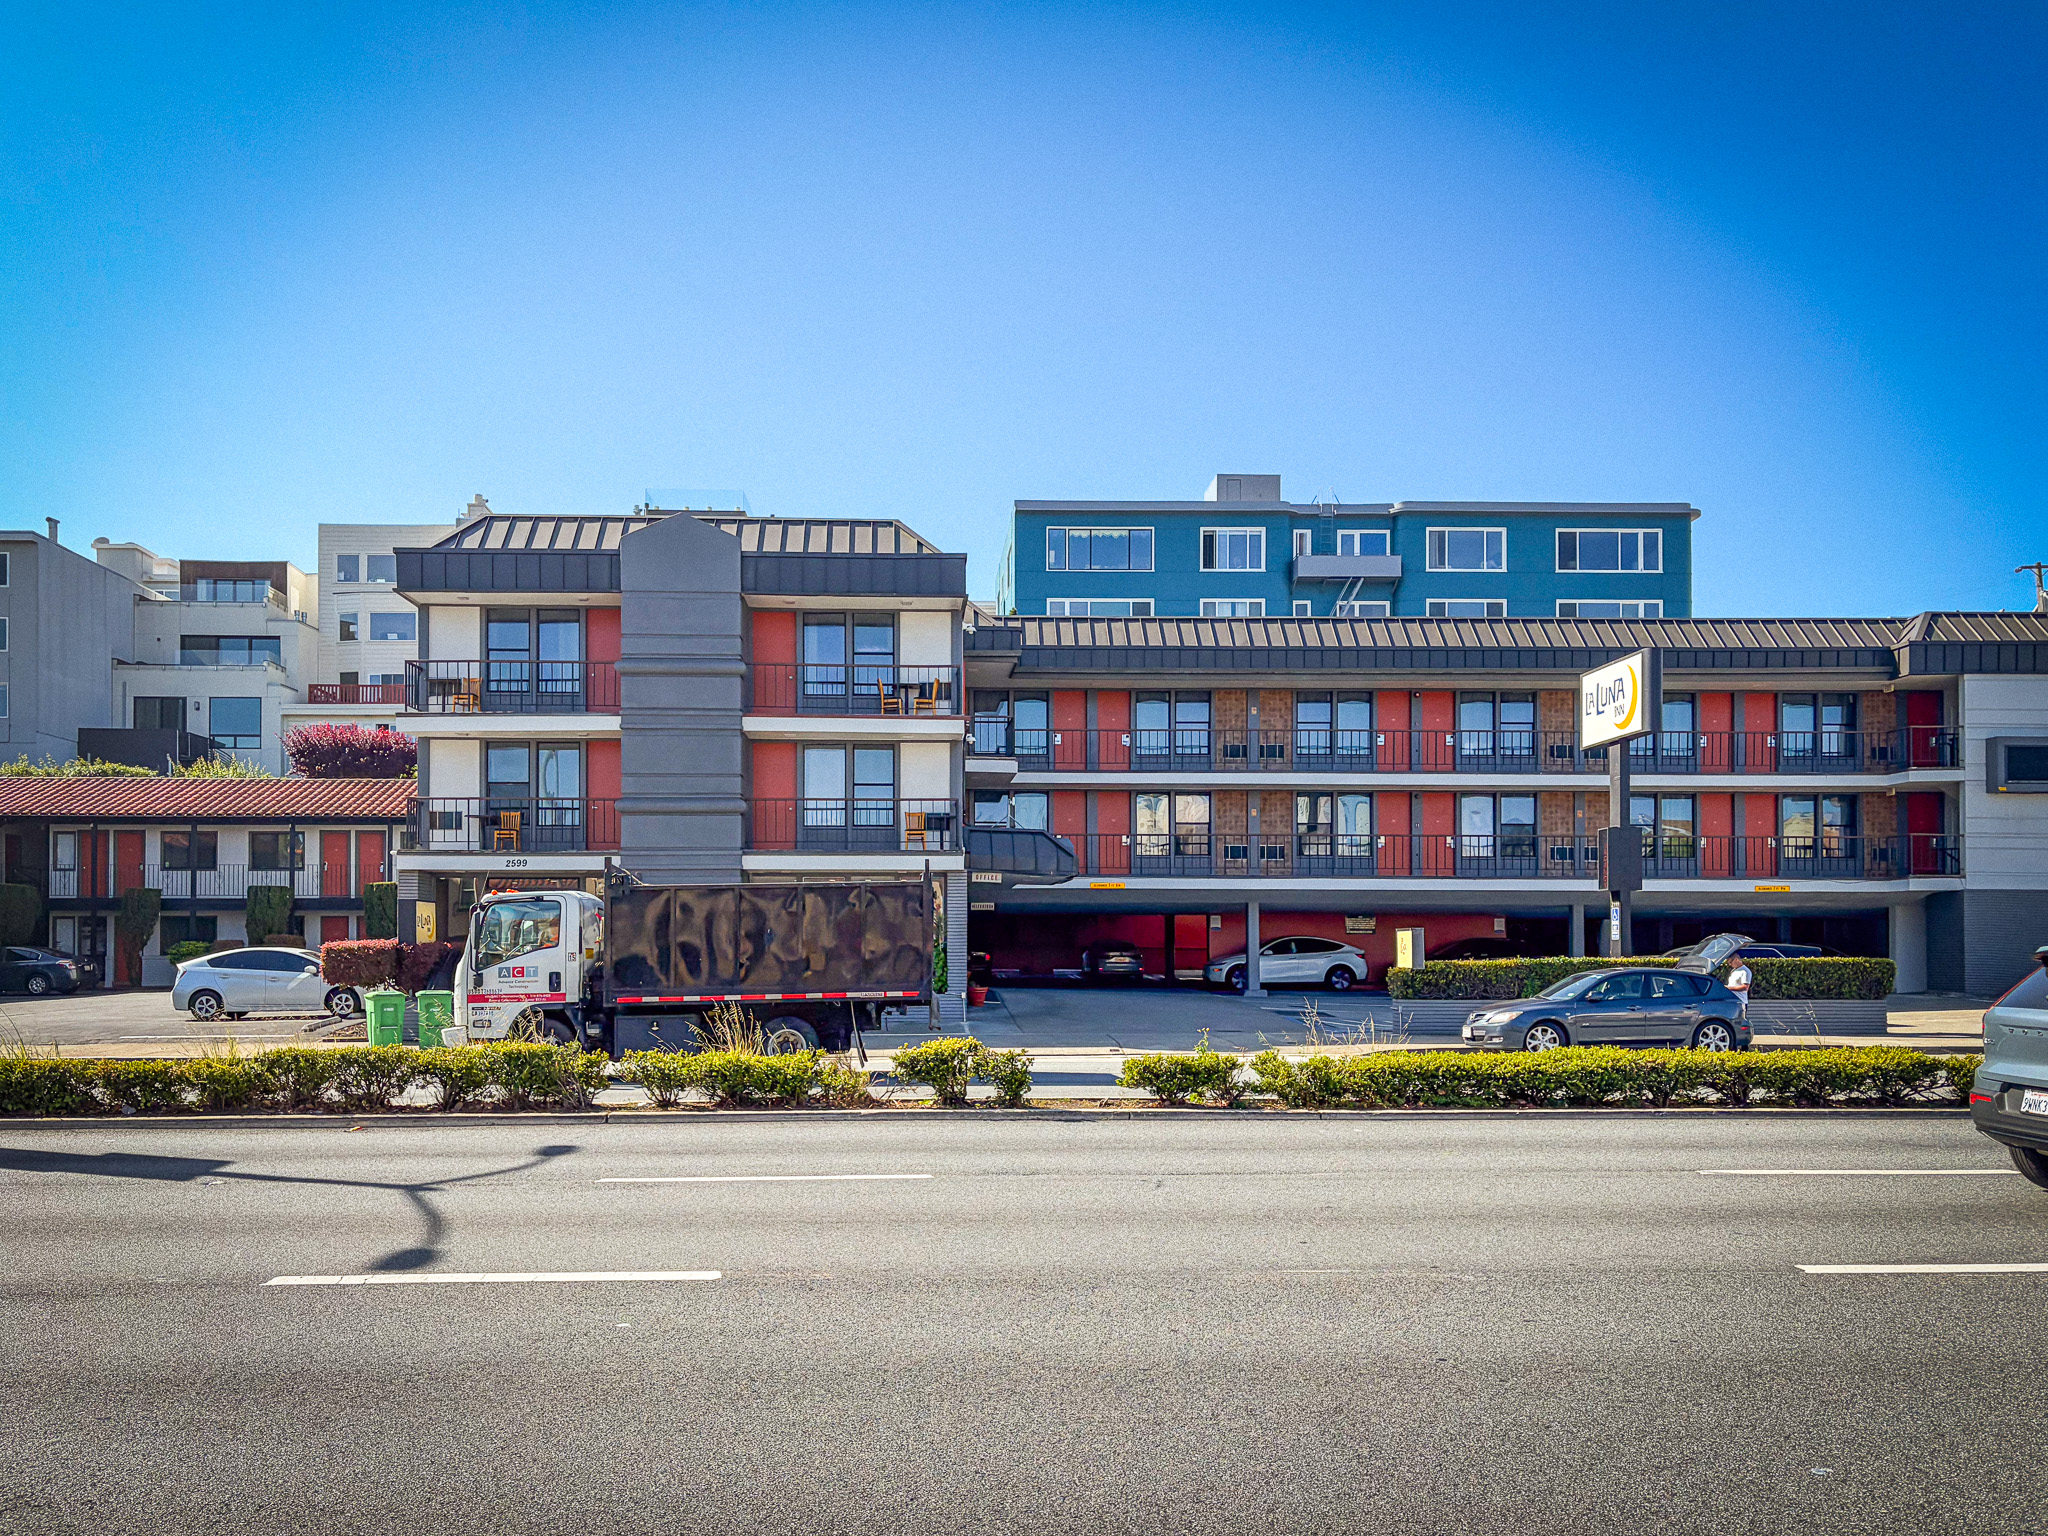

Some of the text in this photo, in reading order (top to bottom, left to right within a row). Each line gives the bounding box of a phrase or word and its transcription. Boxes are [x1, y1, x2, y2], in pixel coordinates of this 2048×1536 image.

[1586, 677, 1625, 716] LA LUNA
[1614, 703, 1625, 718] INN
[505, 859, 528, 868] 2599
[499, 966, 537, 978] ACT
